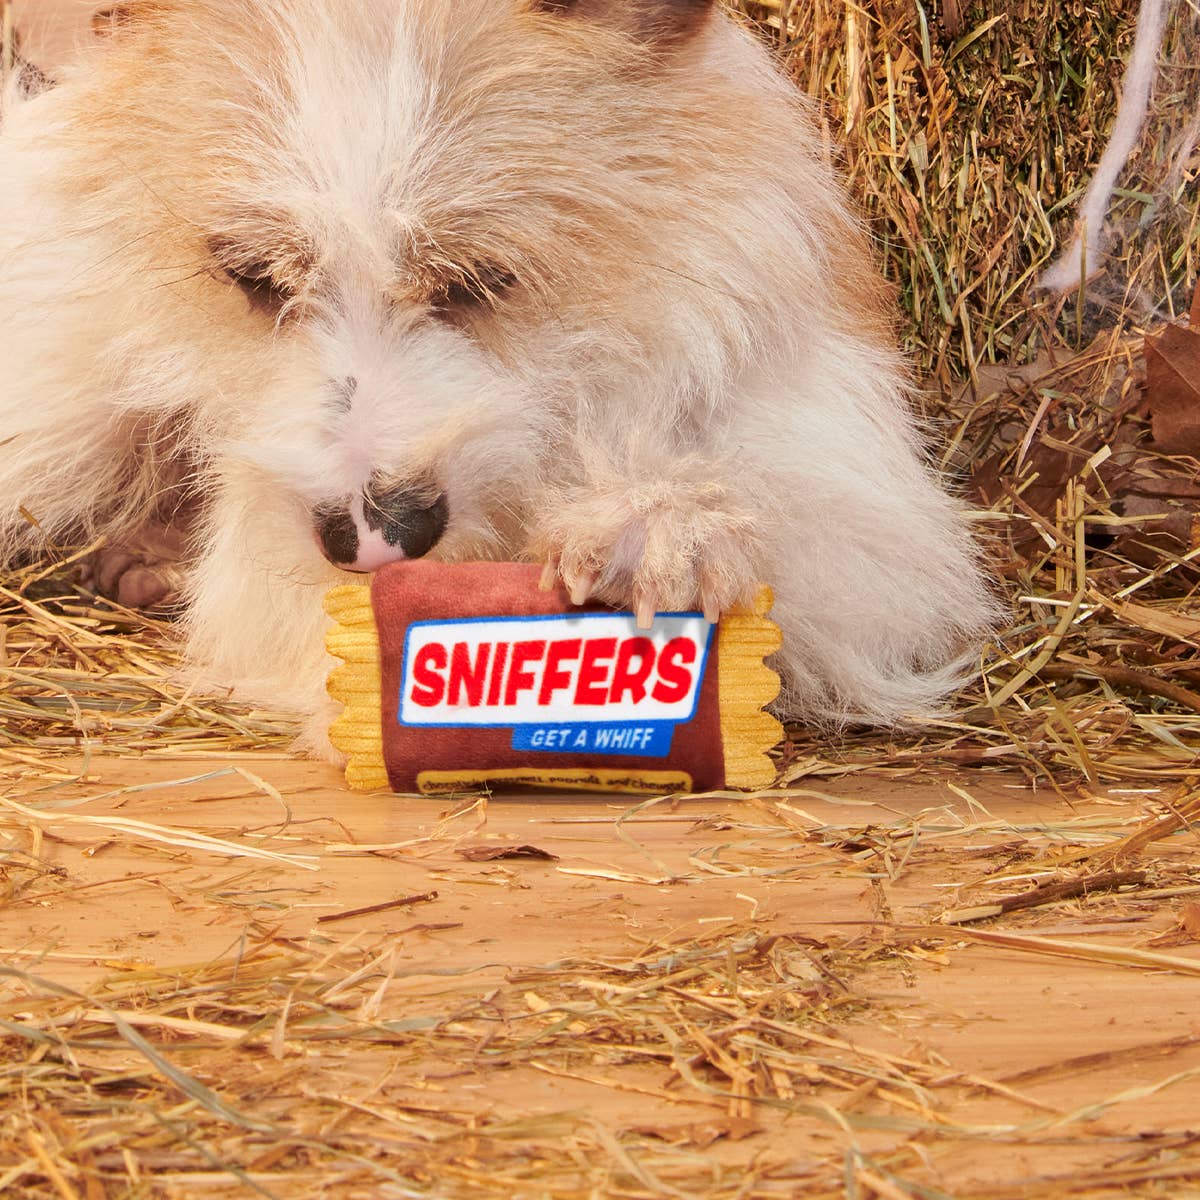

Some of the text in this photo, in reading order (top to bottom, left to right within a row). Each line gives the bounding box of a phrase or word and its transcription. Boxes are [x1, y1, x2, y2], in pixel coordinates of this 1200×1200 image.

[410, 636, 697, 707] SNIFFERS
[530, 727, 655, 750] GET A WHIFF
